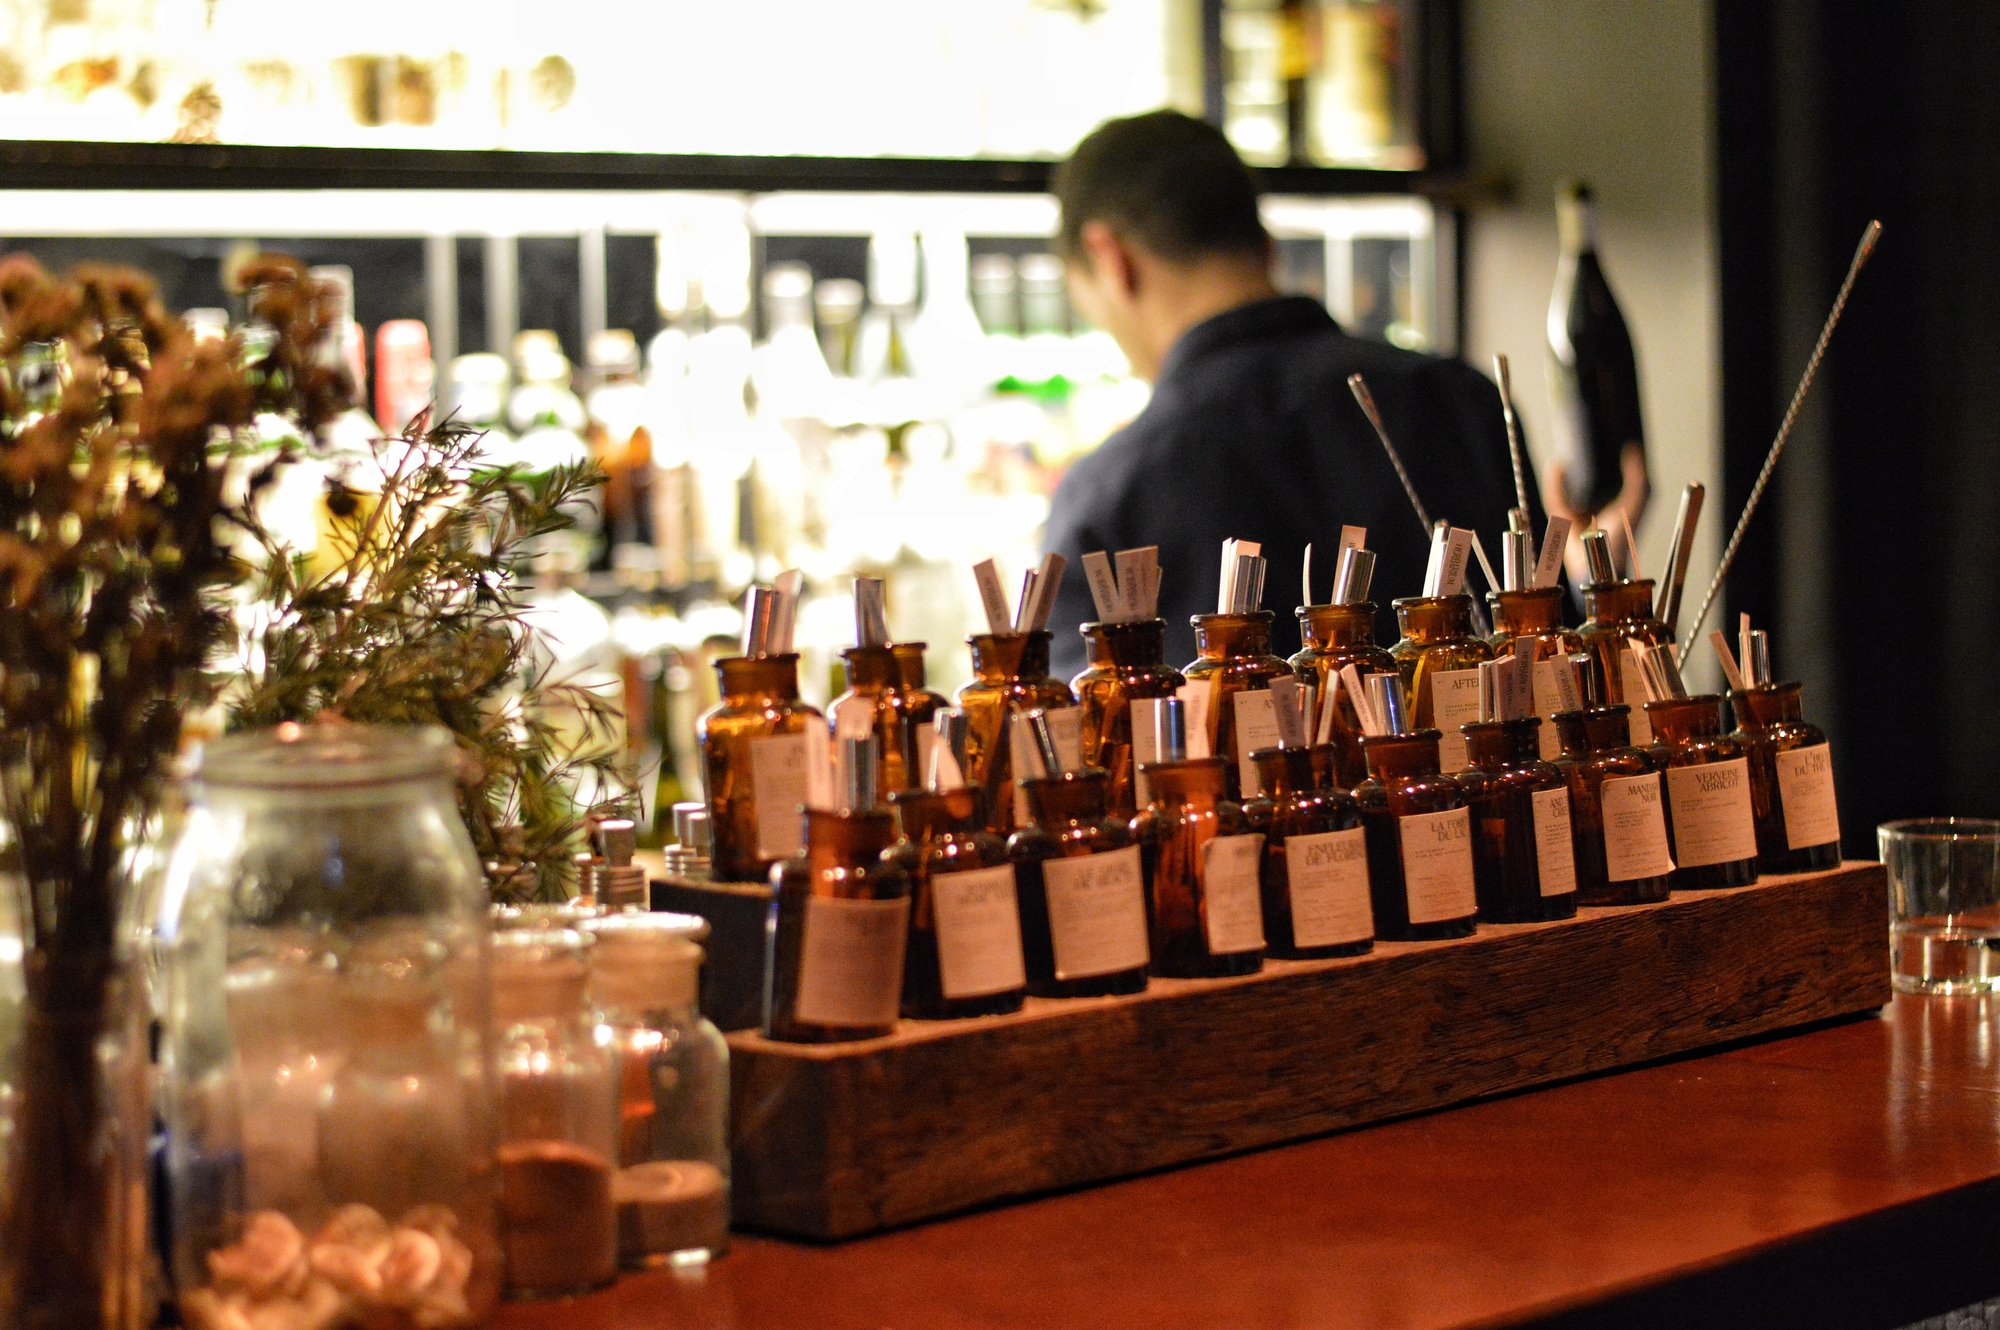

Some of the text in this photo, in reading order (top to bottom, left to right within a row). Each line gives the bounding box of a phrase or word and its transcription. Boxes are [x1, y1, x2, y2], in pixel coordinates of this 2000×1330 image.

[1545, 530, 1562, 572] HERBARIUM
[1447, 543, 1463, 585] HERBARIUM
[1696, 768, 1740, 783] VERVEINE
[1699, 777, 1739, 793] ABRICOT
[1431, 820, 1445, 833] LA
